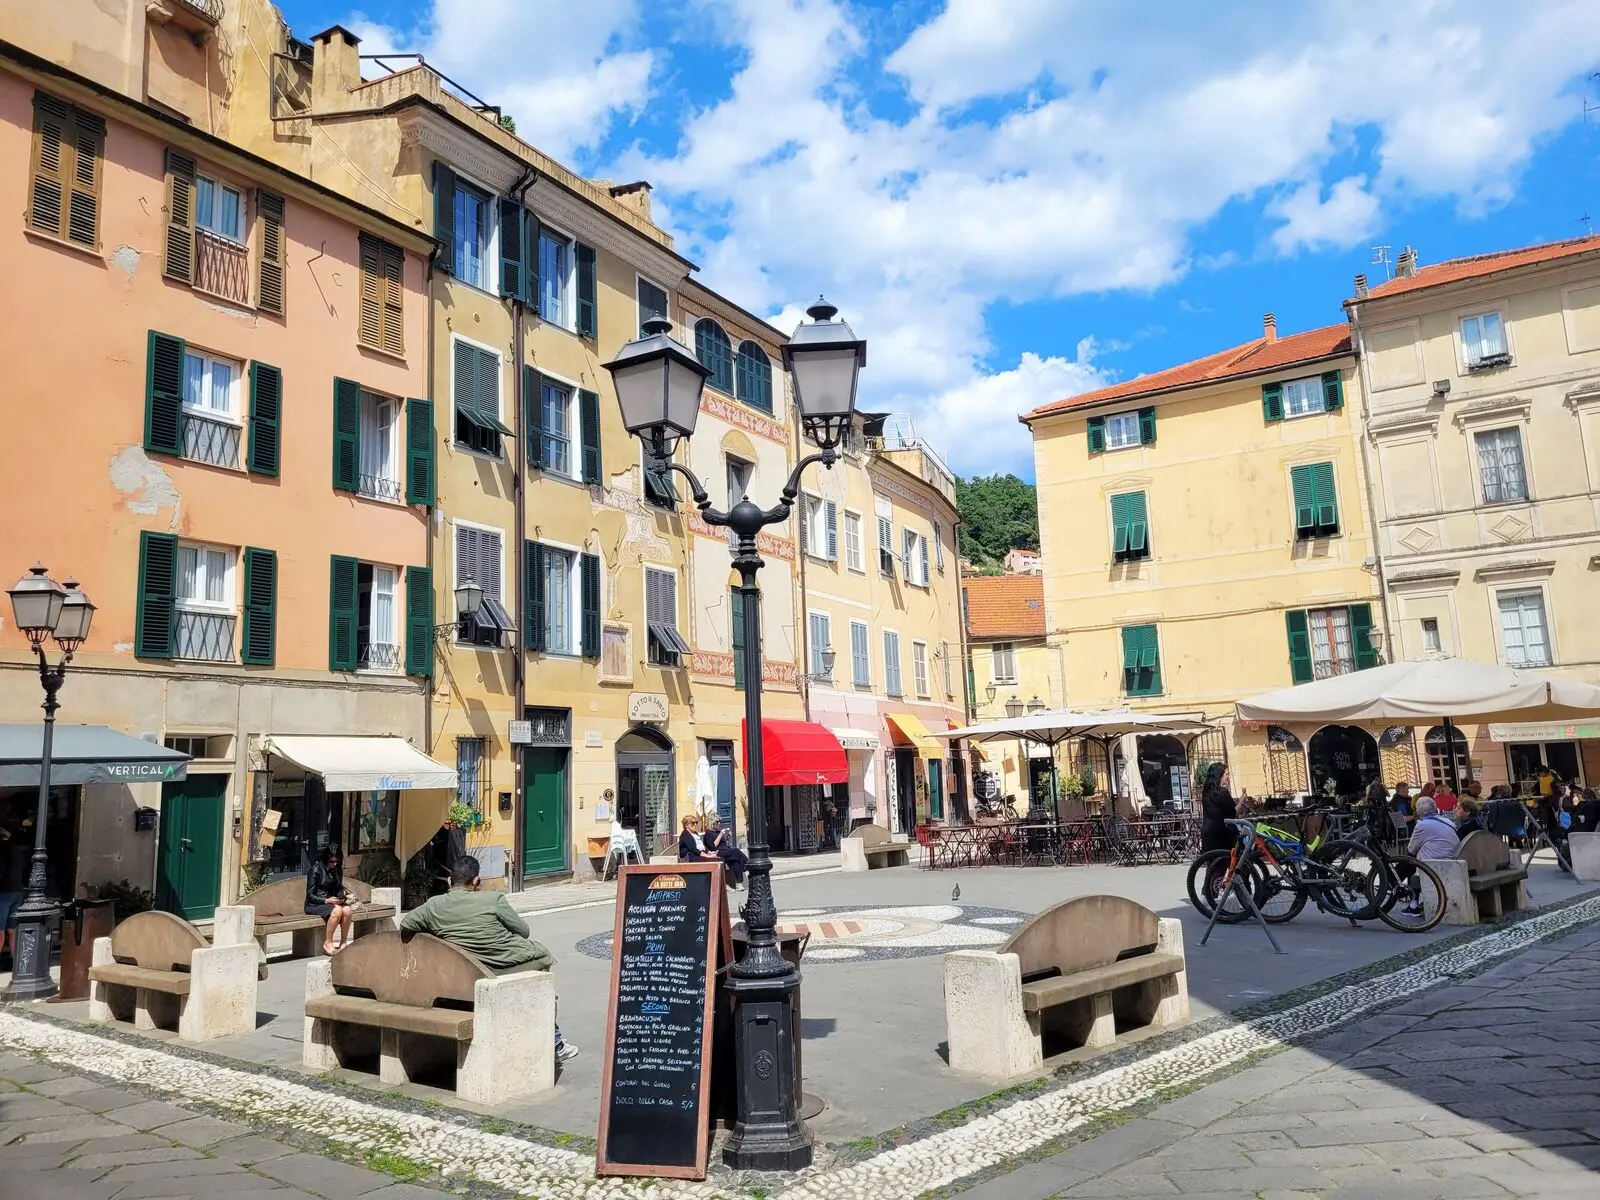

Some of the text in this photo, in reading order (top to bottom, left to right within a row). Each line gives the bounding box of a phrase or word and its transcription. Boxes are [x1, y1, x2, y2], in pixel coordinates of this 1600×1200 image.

[632, 697, 647, 716] SOTTO
[654, 698, 665, 717] SANTO
[108, 766, 164, 775] VERTICAL
[646, 890, 681, 902] ANTIPASTI
[626, 917, 652, 926] INSALATA
[646, 942, 665, 952] PRIMI
[641, 1002, 670, 1011] SECONDI
[616, 1096, 633, 1104] DOLCI
